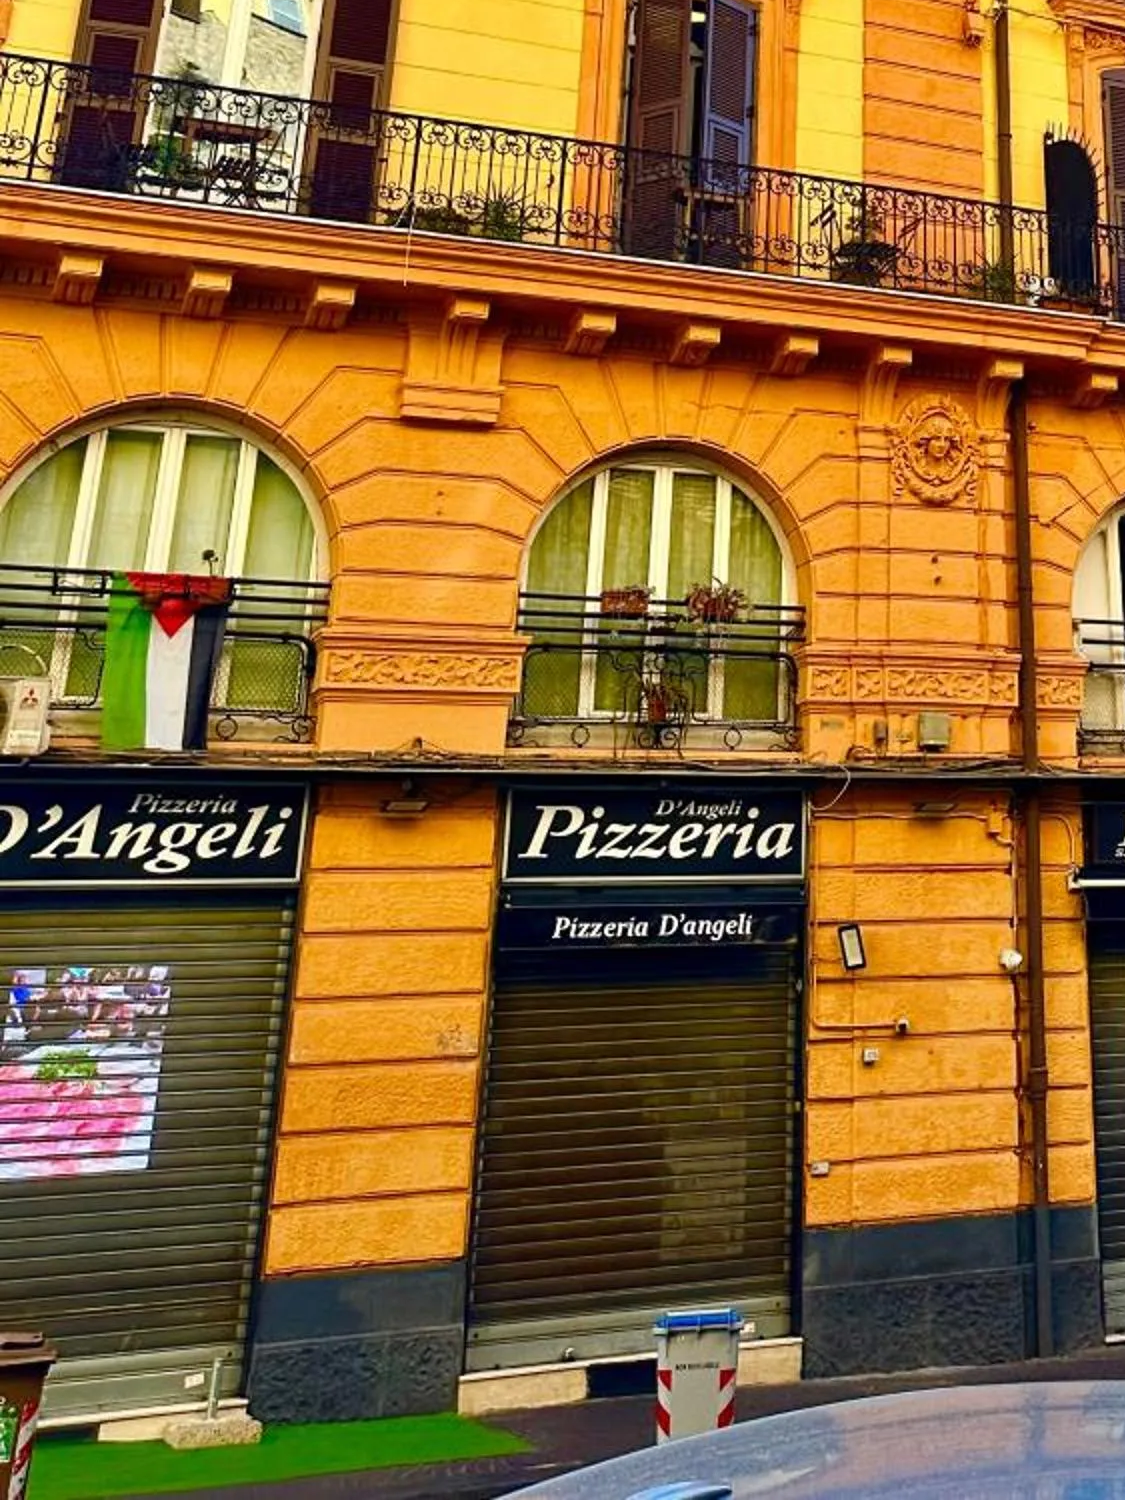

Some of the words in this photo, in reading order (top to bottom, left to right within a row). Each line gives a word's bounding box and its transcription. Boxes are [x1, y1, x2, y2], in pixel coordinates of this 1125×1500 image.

[128, 793, 238, 814] Pizzeria
[655, 799, 744, 820] D'Angeli
[517, 805, 796, 860] Pizzeria
[551, 915, 649, 940] Pizzeria
[658, 912, 753, 942] D'angeli
